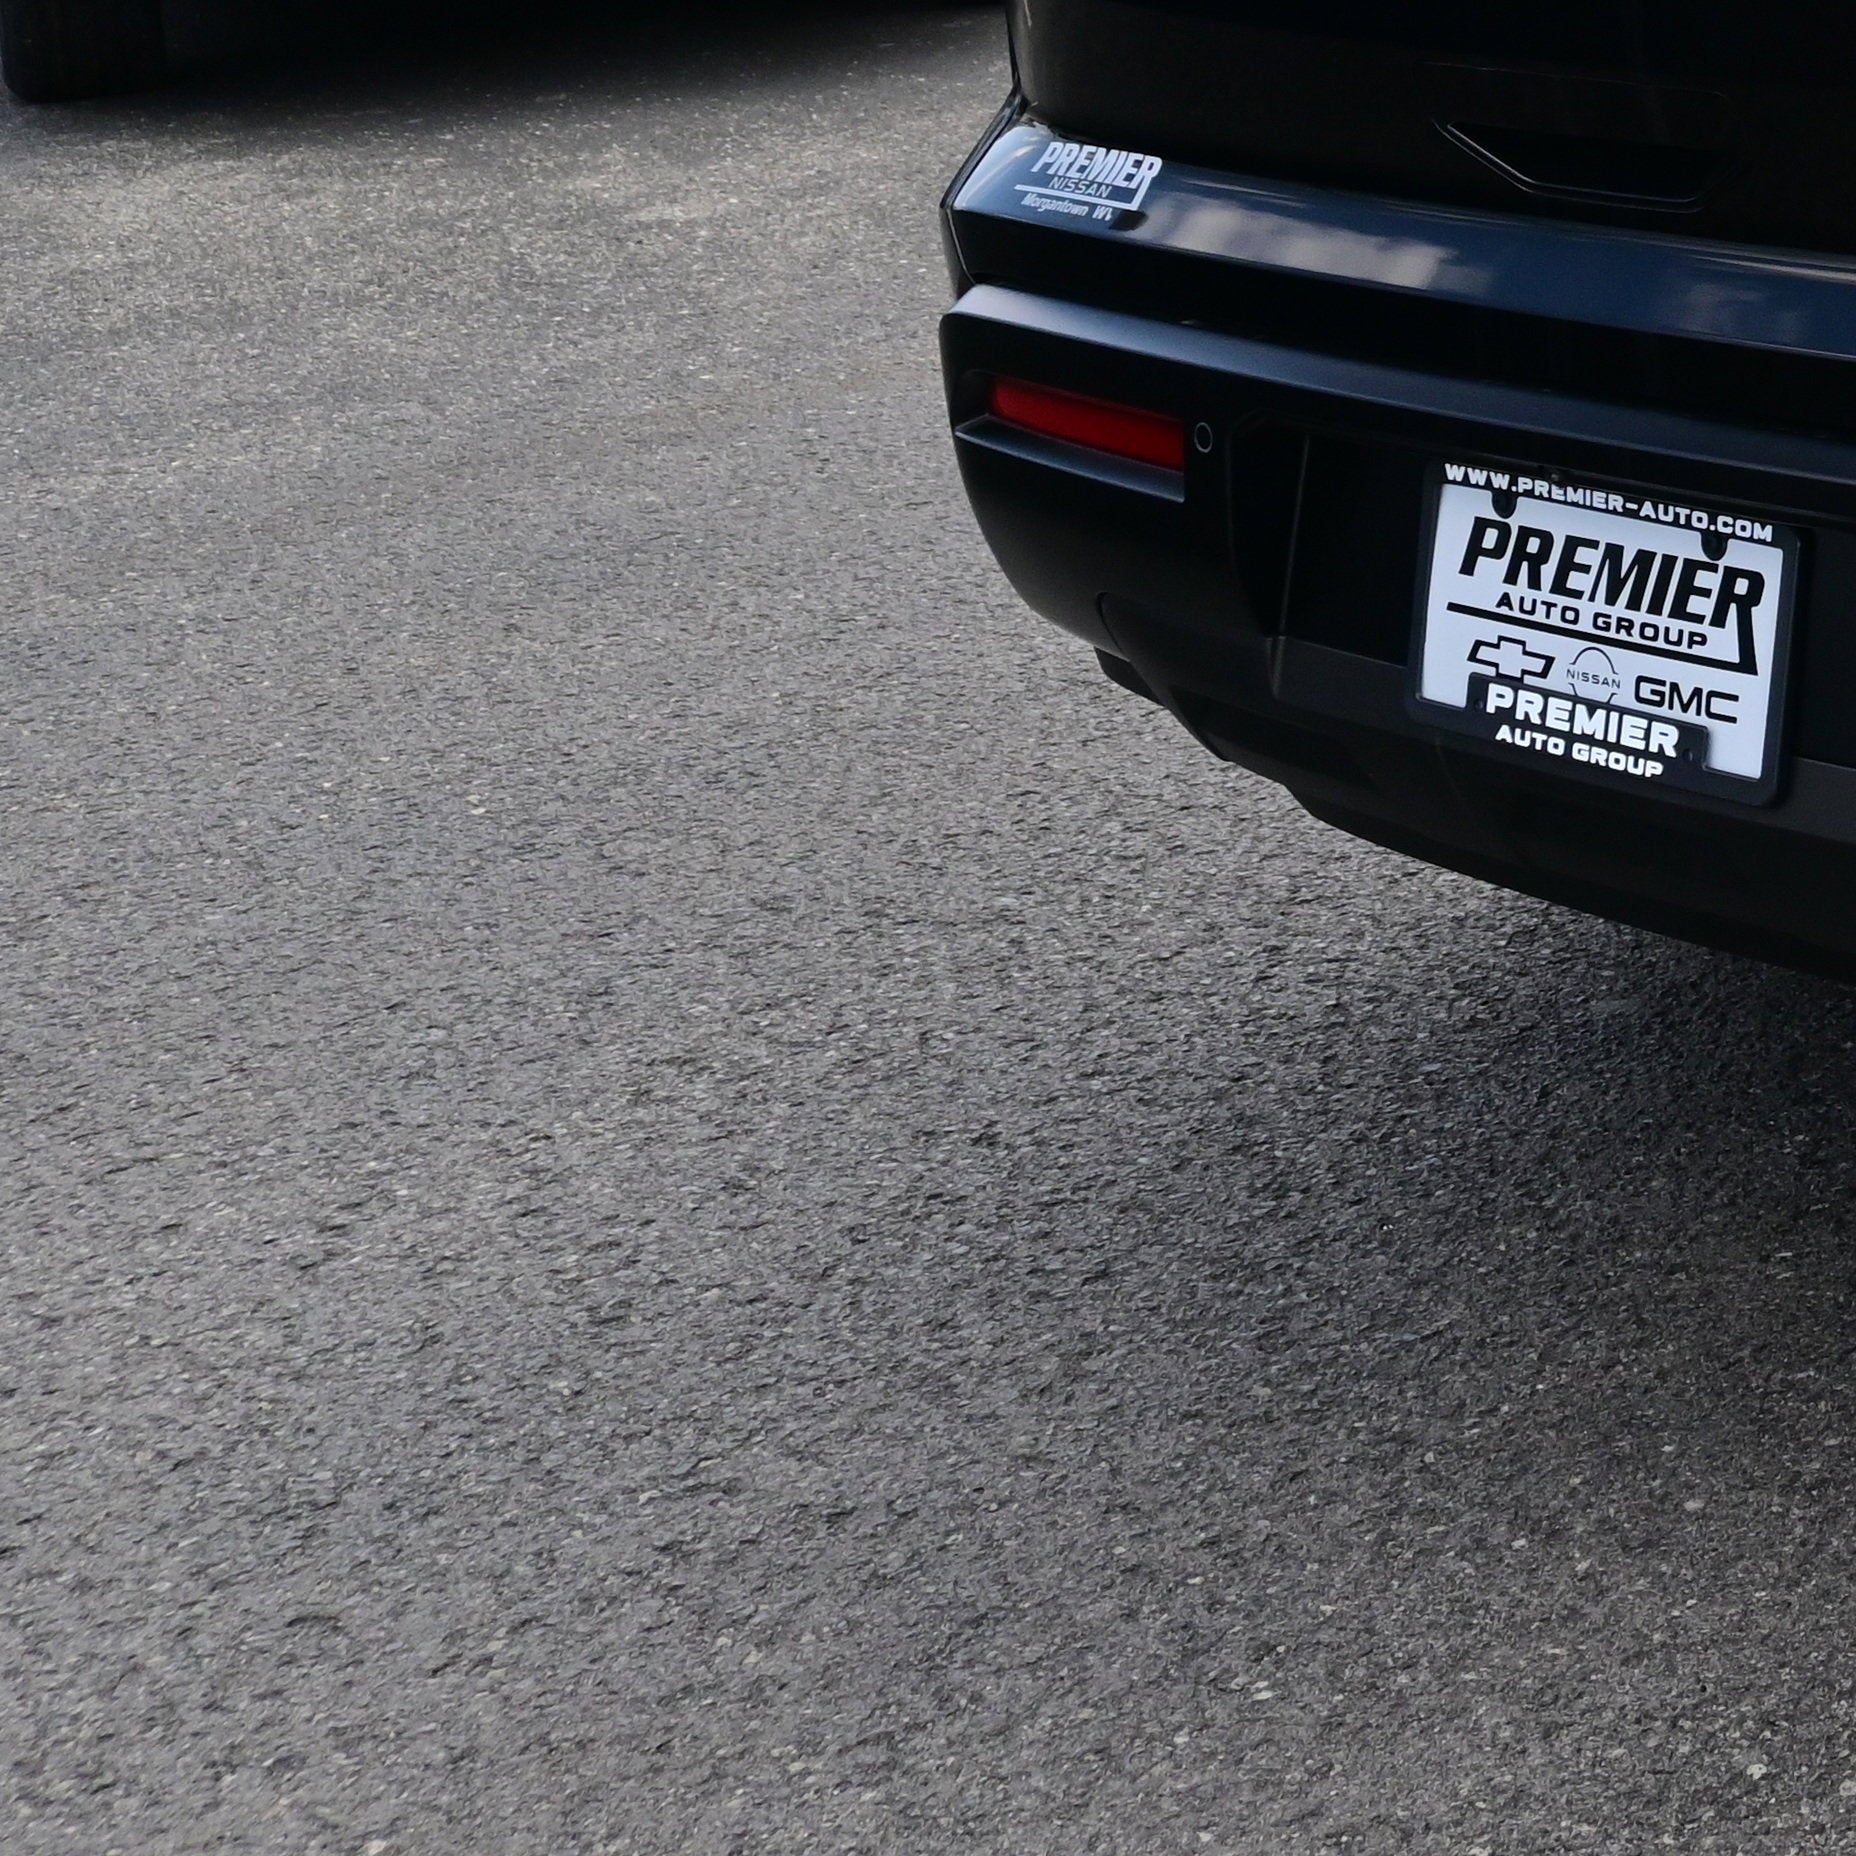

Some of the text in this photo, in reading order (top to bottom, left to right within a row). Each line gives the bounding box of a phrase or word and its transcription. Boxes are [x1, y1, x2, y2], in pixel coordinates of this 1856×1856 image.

[1030, 141, 1163, 206] PREMIER
[1048, 176, 1113, 199] NISSAN
[1020, 192, 1090, 218] Morgantown
[1444, 462, 1774, 543] WWW.PREMIER-AUTO.COM
[1458, 515, 1766, 670] PREMIER
[1494, 591, 1709, 651] AUTO GROUP
[1566, 667, 1622, 690] NISSAN
[1634, 674, 1741, 725] GMC
[1485, 685, 1680, 758] PREMIER
[1494, 723, 1665, 779] AUTO GROUP
